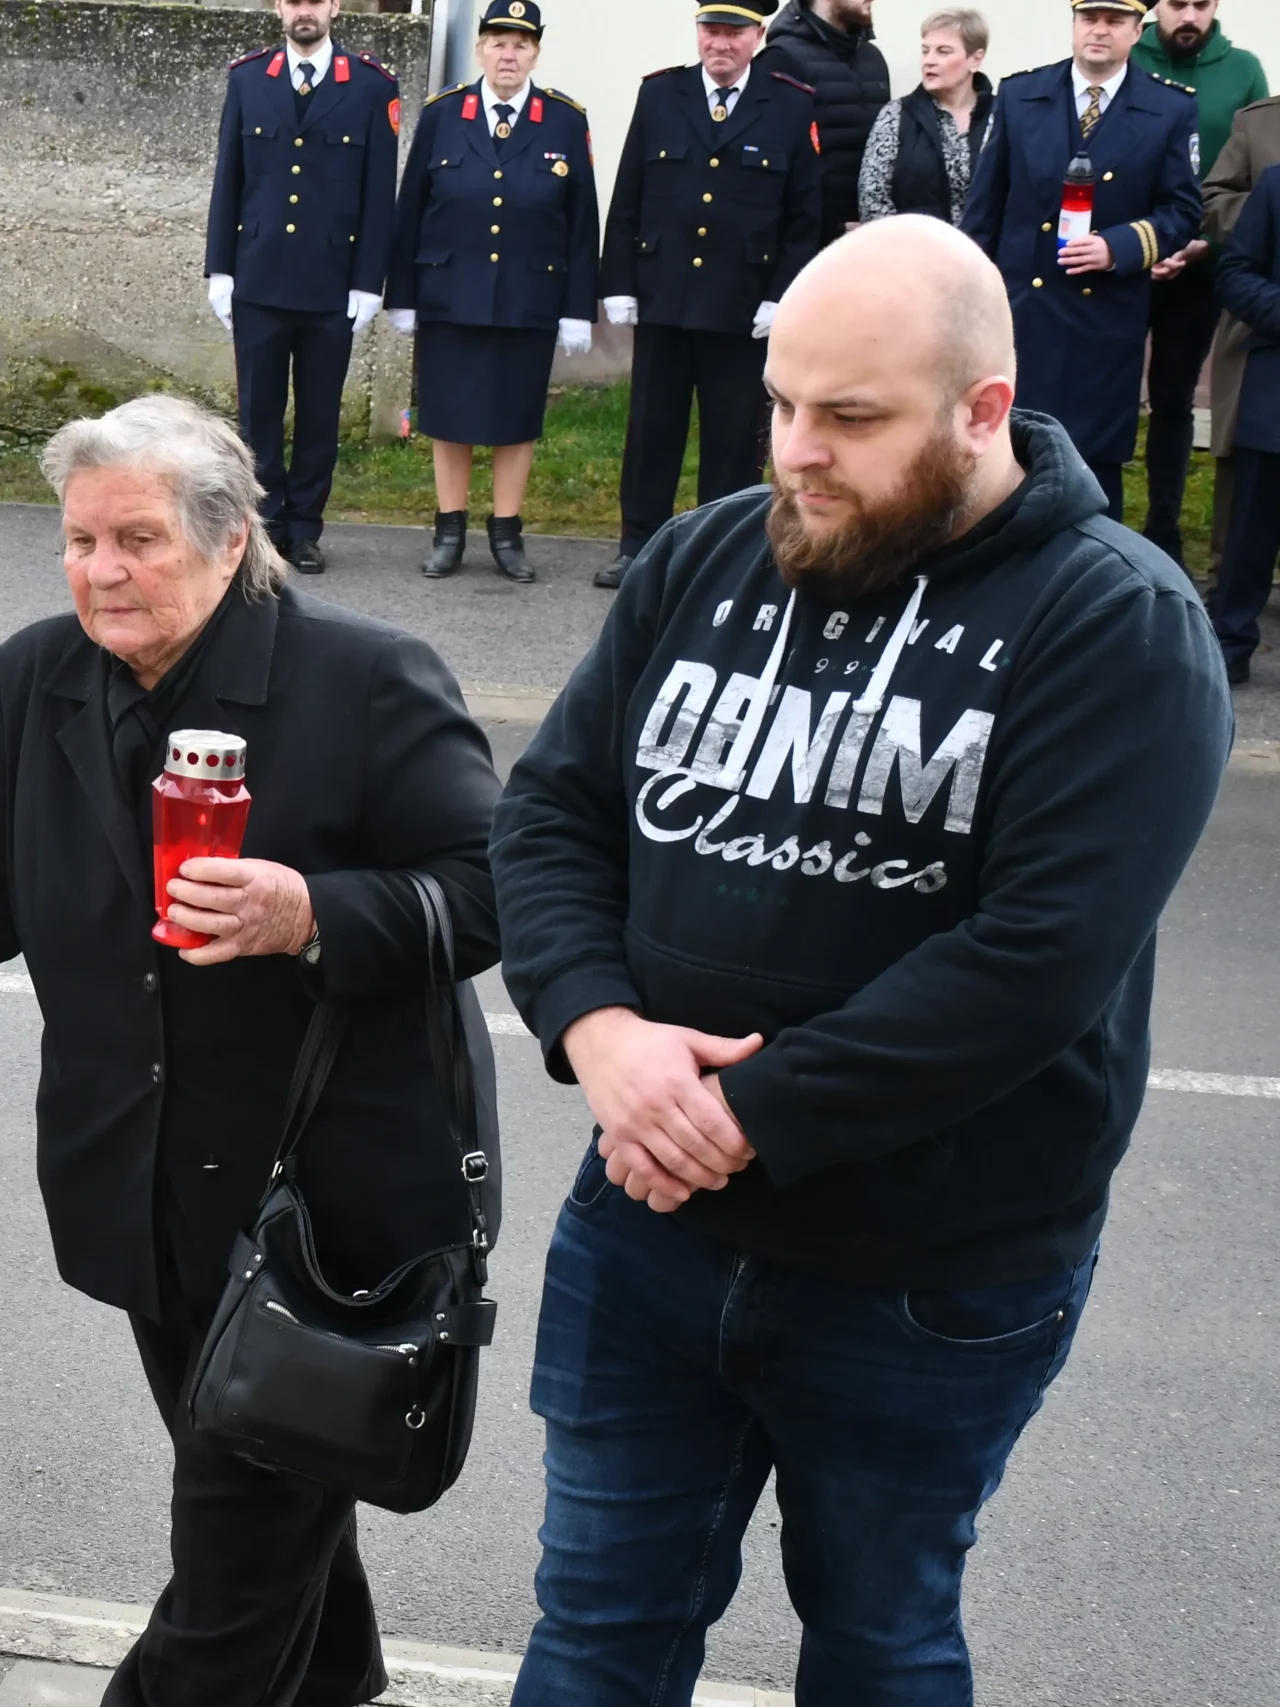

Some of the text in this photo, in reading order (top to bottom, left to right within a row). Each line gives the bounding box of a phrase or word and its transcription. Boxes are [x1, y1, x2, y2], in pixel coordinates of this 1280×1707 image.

[712, 600, 1004, 671] ORGINAL
[635, 659, 995, 835] DENIM
[635, 770, 948, 893] Classics
